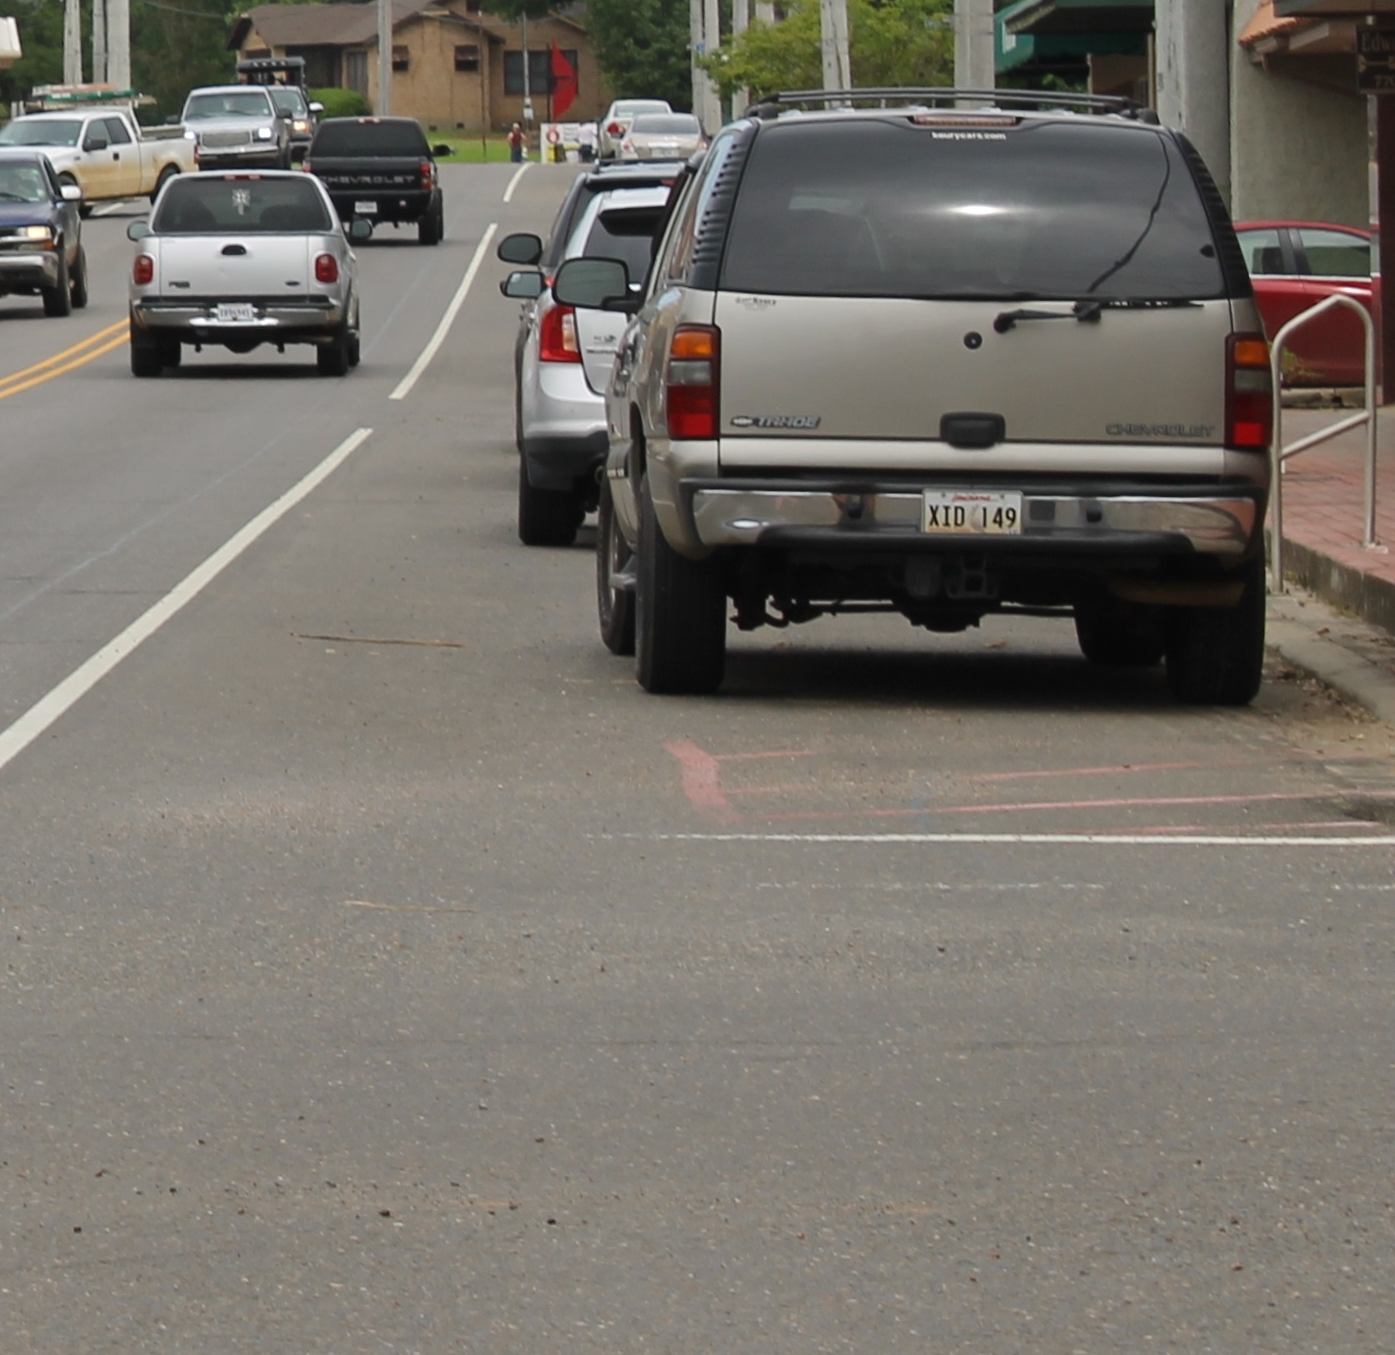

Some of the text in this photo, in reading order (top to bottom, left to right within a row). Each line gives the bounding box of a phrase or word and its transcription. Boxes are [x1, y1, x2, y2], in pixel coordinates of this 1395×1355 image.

[757, 416, 1215, 437] TAHOE CHEVROLET
[929, 504, 1017, 529] XID 149
